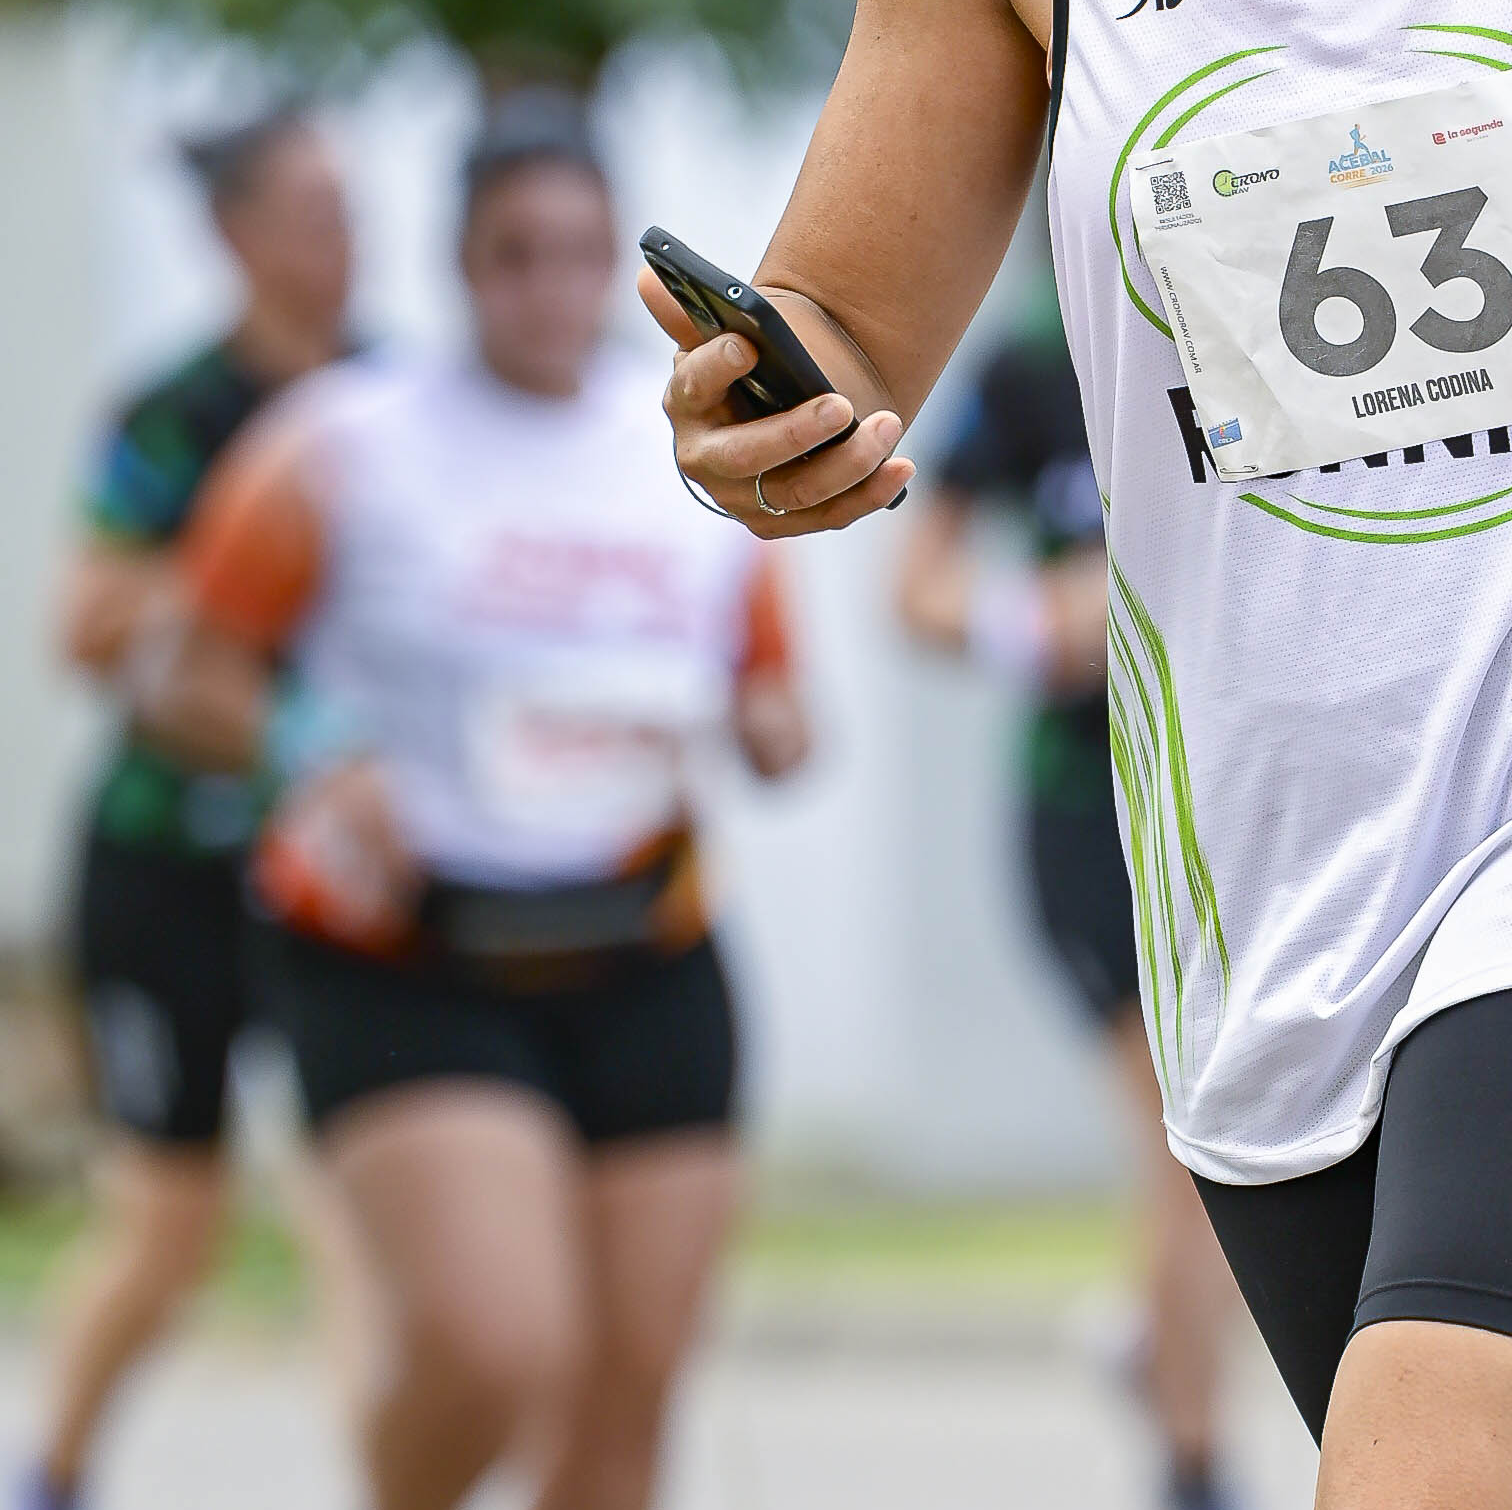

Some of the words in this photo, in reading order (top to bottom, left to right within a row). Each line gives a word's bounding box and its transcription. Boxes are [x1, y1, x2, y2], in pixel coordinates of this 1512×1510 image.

[1328, 149, 1392, 174] ACEBAL
[1330, 168, 1367, 184] CORRE
[1351, 382, 1425, 418] LORENA
[1426, 368, 1494, 402] CODINA
